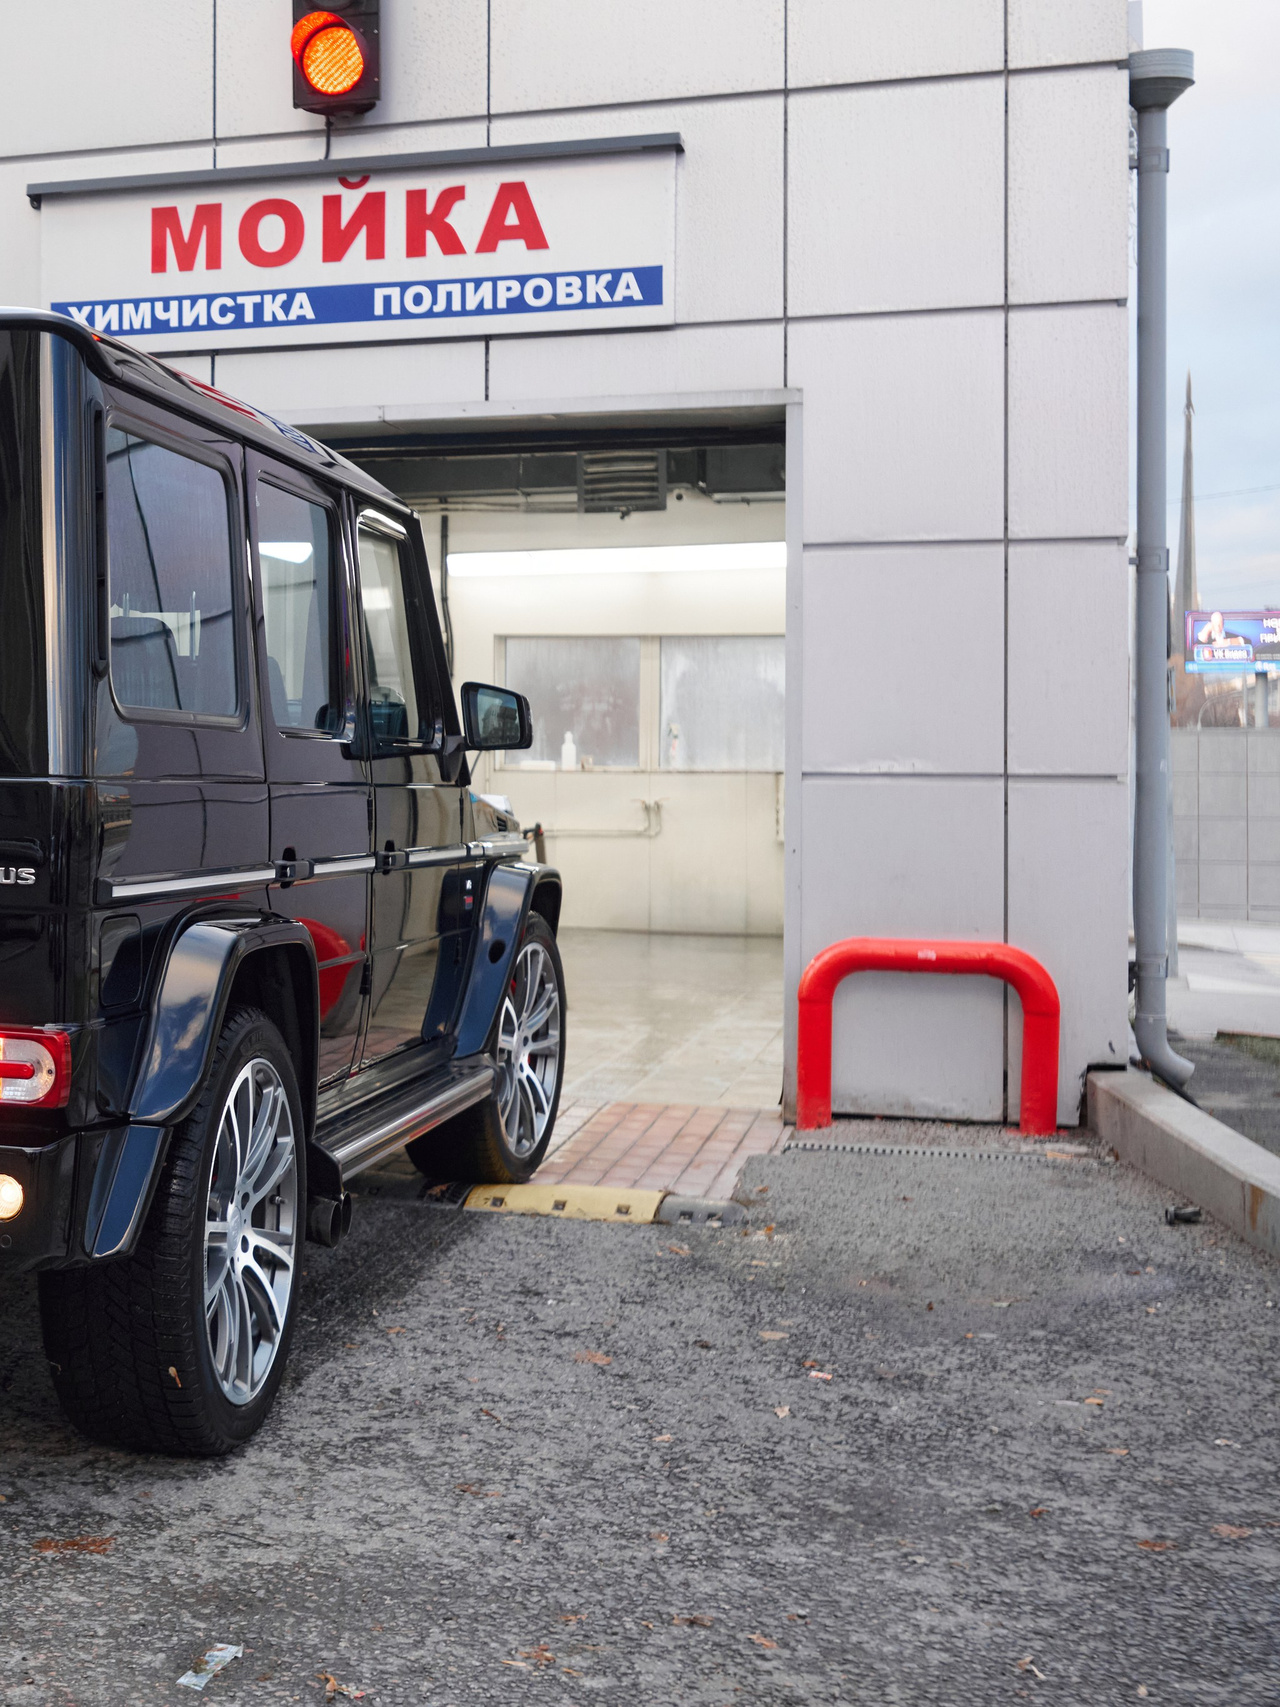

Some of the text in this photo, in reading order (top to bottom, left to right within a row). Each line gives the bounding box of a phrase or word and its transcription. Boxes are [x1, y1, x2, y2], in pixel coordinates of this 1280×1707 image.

[151, 175, 549, 274] МОЙКА
[68, 271, 644, 333] ХИМЧИСТКА ПОЛИРОВКА
